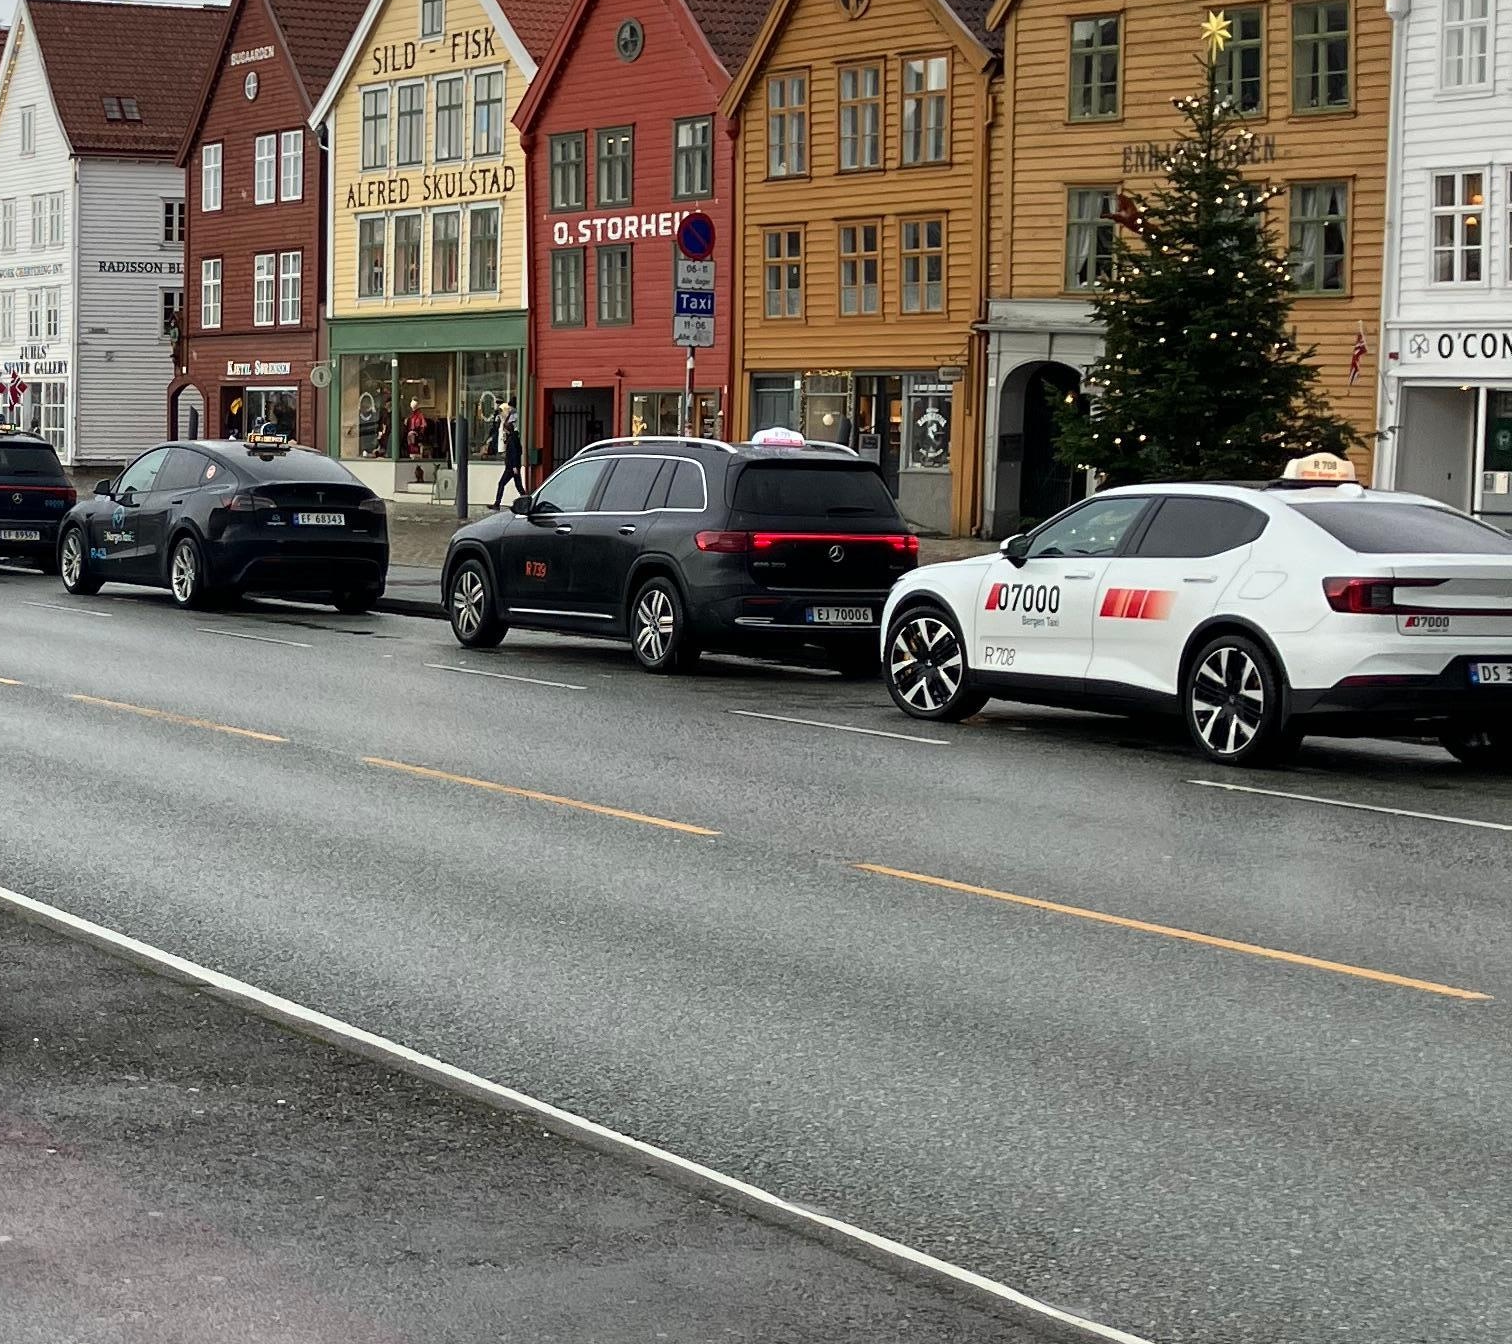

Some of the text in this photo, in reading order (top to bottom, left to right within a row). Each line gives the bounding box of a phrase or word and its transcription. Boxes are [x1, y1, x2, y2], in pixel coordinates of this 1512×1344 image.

[373, 41, 416, 75] SILD
[451, 26, 496, 63] FISK
[346, 165, 515, 208] ALFRED SKULSTAD
[577, 210, 702, 244] STORHEI
[98, 261, 163, 273] RADISSON
[680, 293, 712, 310] Taxi
[34, 360, 68, 375] GALLERY
[1313, 460, 1338, 471] R 708
[300, 515, 343, 525] EF 68343
[525, 561, 532, 576] R
[998, 583, 1060, 614] 07000
[817, 608, 869, 622] EJ 70006
[1021, 615, 1045, 629] Bergen
[1413, 616, 1450, 628] 07000
[984, 646, 1016, 666] R 708
[1481, 665, 1501, 682] DS
